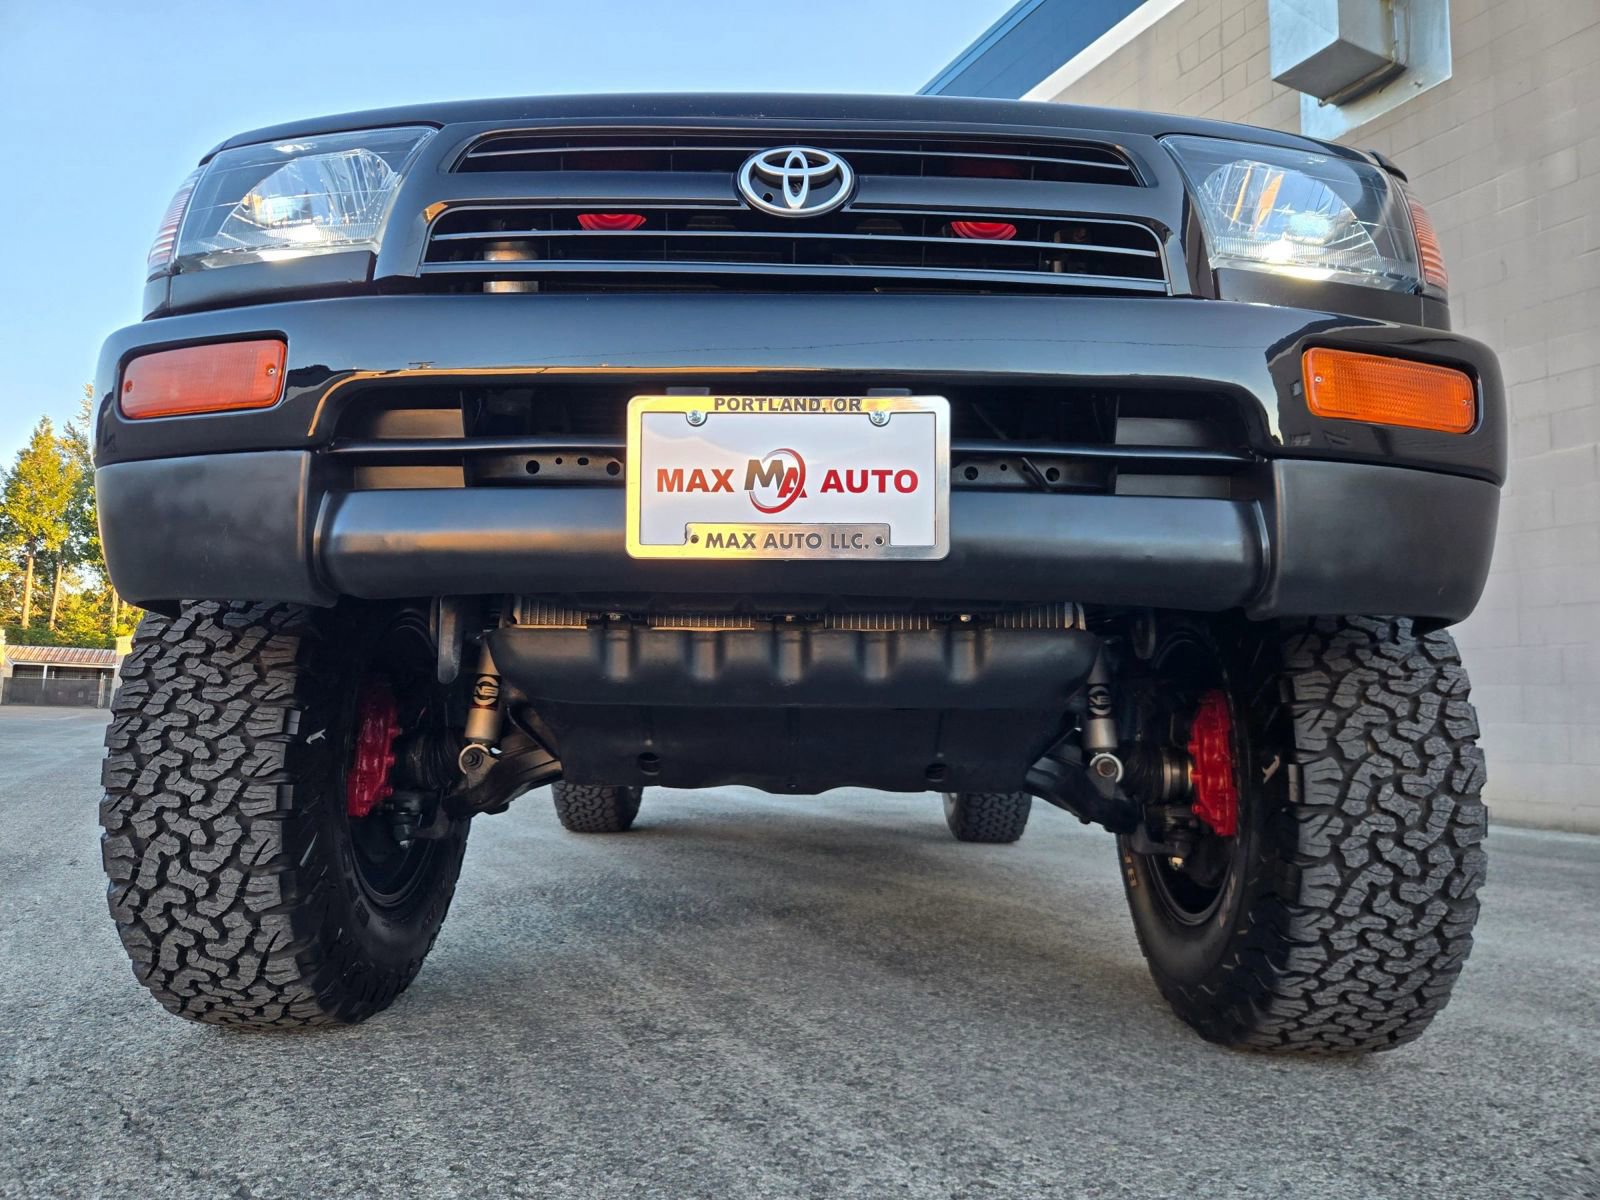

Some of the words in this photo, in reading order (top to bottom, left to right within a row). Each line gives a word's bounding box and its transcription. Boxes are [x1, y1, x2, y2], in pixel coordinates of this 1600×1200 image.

[714, 398, 826, 413] PORTLAND,
[833, 398, 861, 411] OR
[656, 469, 735, 493] MAX
[820, 470, 919, 494] AUTO
[705, 533, 757, 549] MAX
[763, 534, 822, 550] AUTO
[830, 534, 869, 550] LLC.
